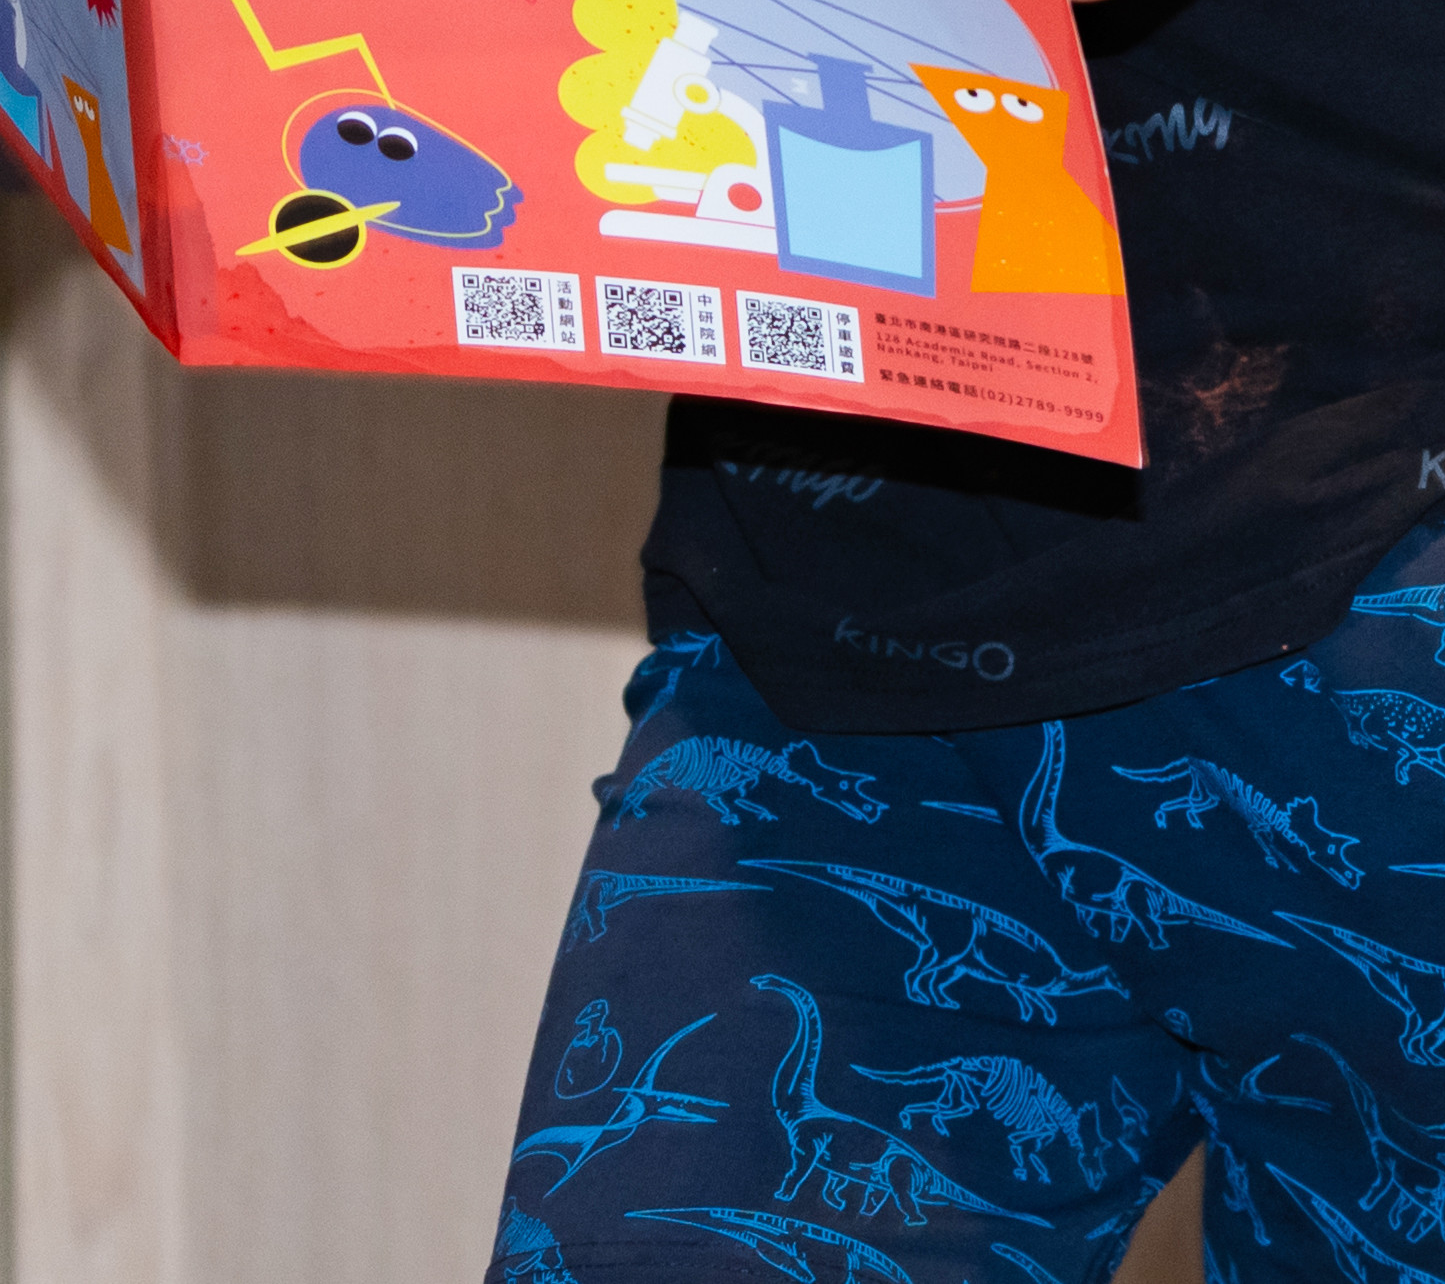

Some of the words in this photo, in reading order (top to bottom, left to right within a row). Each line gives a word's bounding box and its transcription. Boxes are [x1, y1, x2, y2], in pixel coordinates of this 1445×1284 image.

[556, 280, 576, 345] 活動網站
[697, 294, 717, 358] 中研院網
[834, 312, 856, 376] 停車繳費
[874, 311, 1095, 367] 臺北市南港區研究院路二段128號
[876, 331, 900, 345] 128
[905, 335, 976, 360] Academia
[980, 348, 1021, 369] Road,
[1025, 356, 1080, 380] Section
[876, 342, 946, 366] Nankang,
[948, 352, 994, 373] Taipei
[832, 614, 1017, 683] KINGO
